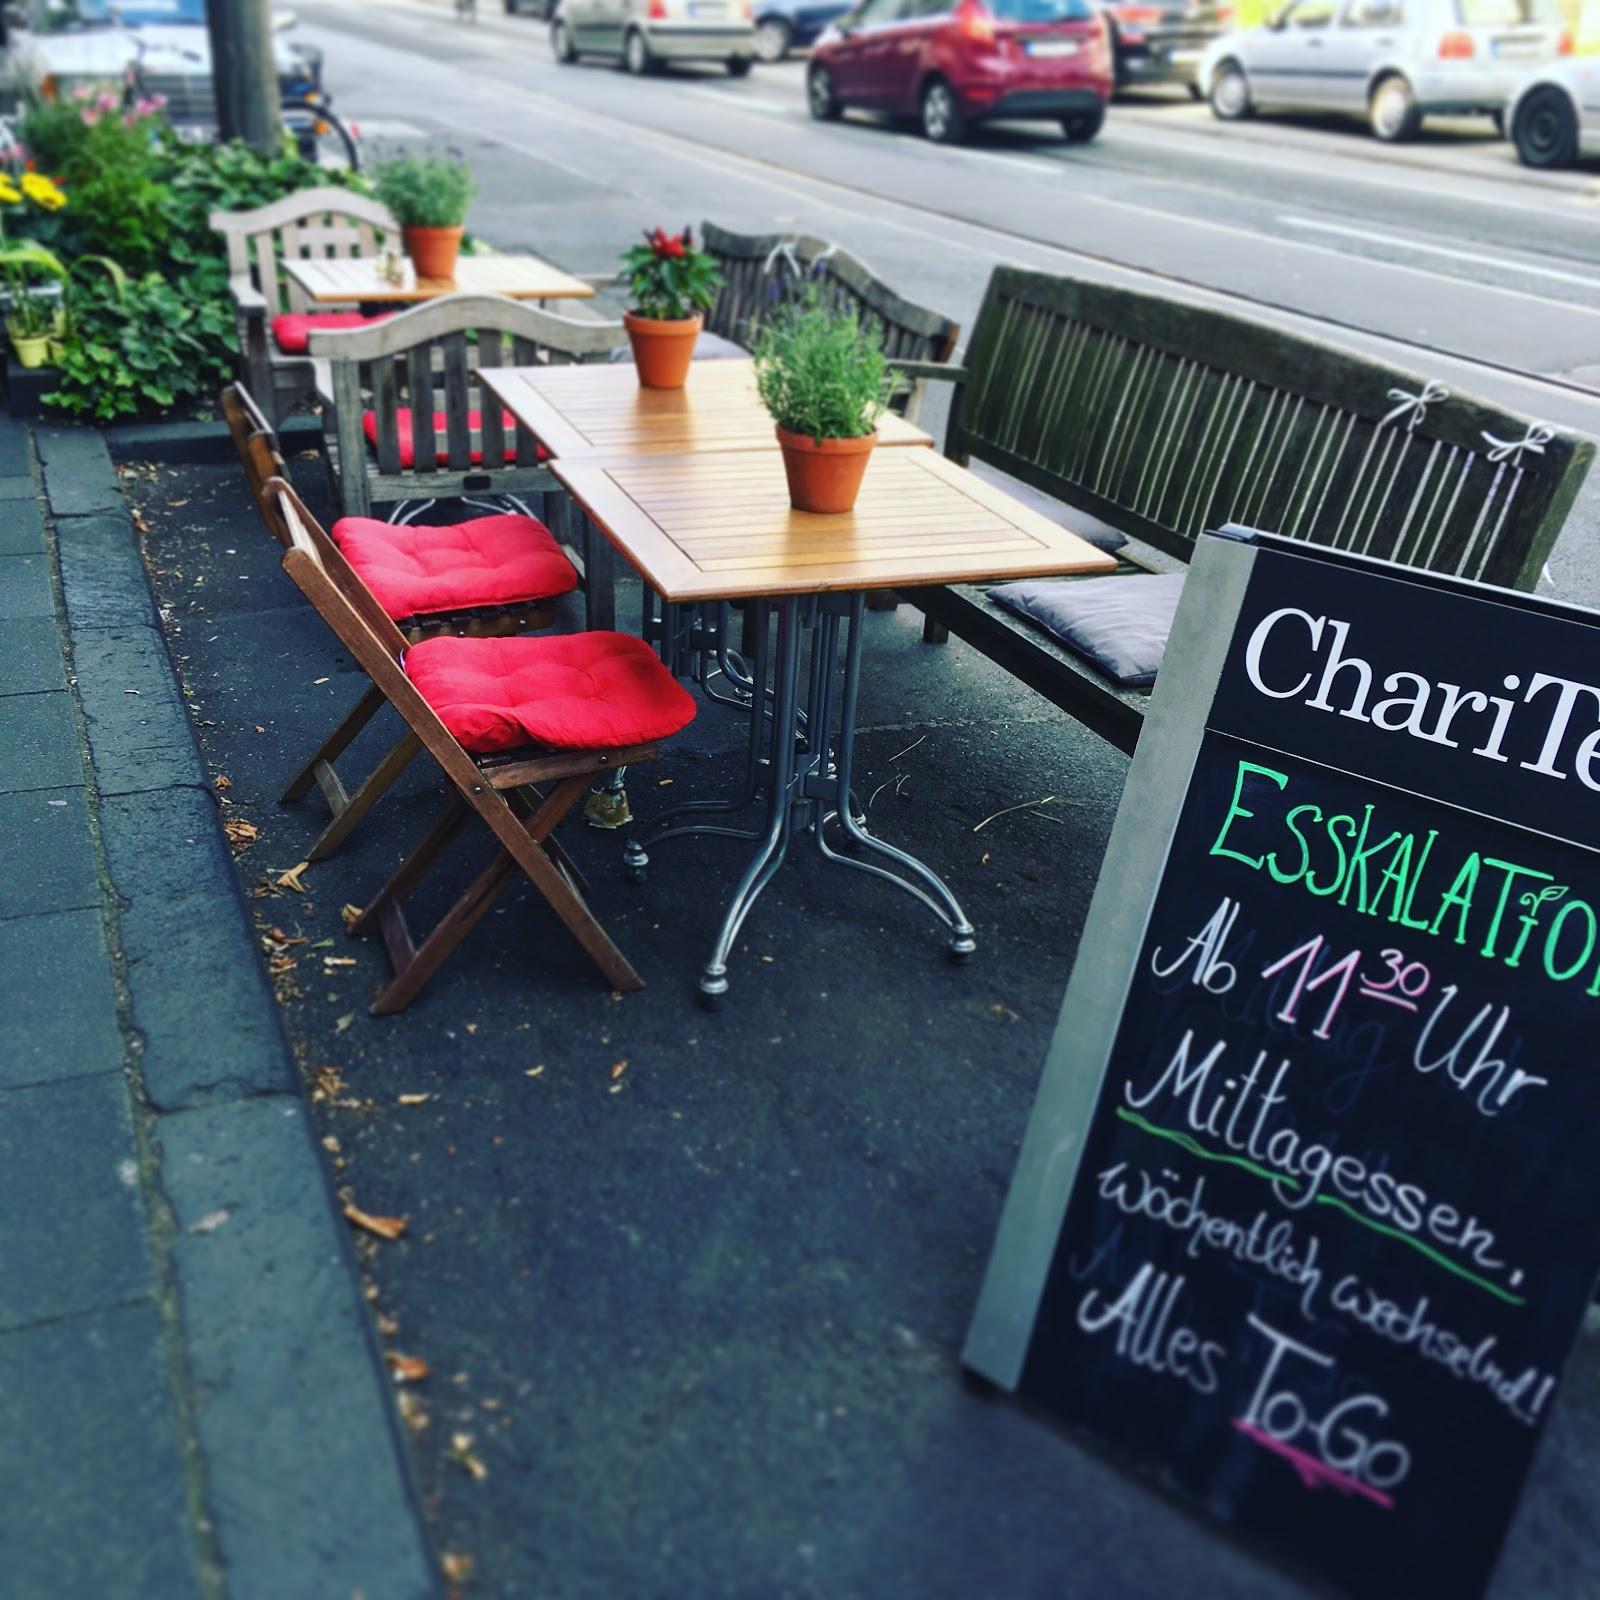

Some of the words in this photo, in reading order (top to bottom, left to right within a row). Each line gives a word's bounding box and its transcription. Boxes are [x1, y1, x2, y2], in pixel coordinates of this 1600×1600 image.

[1209, 760, 1600, 996] ESSKALATiO
[1152, 898, 1238, 993] Ab
[1414, 985, 1547, 1115] Uhr
[1077, 1263, 1226, 1393] Alles
[1097, 1162, 1320, 1321] wöchentlich
[1331, 1275, 1555, 1424] wechselnd!
